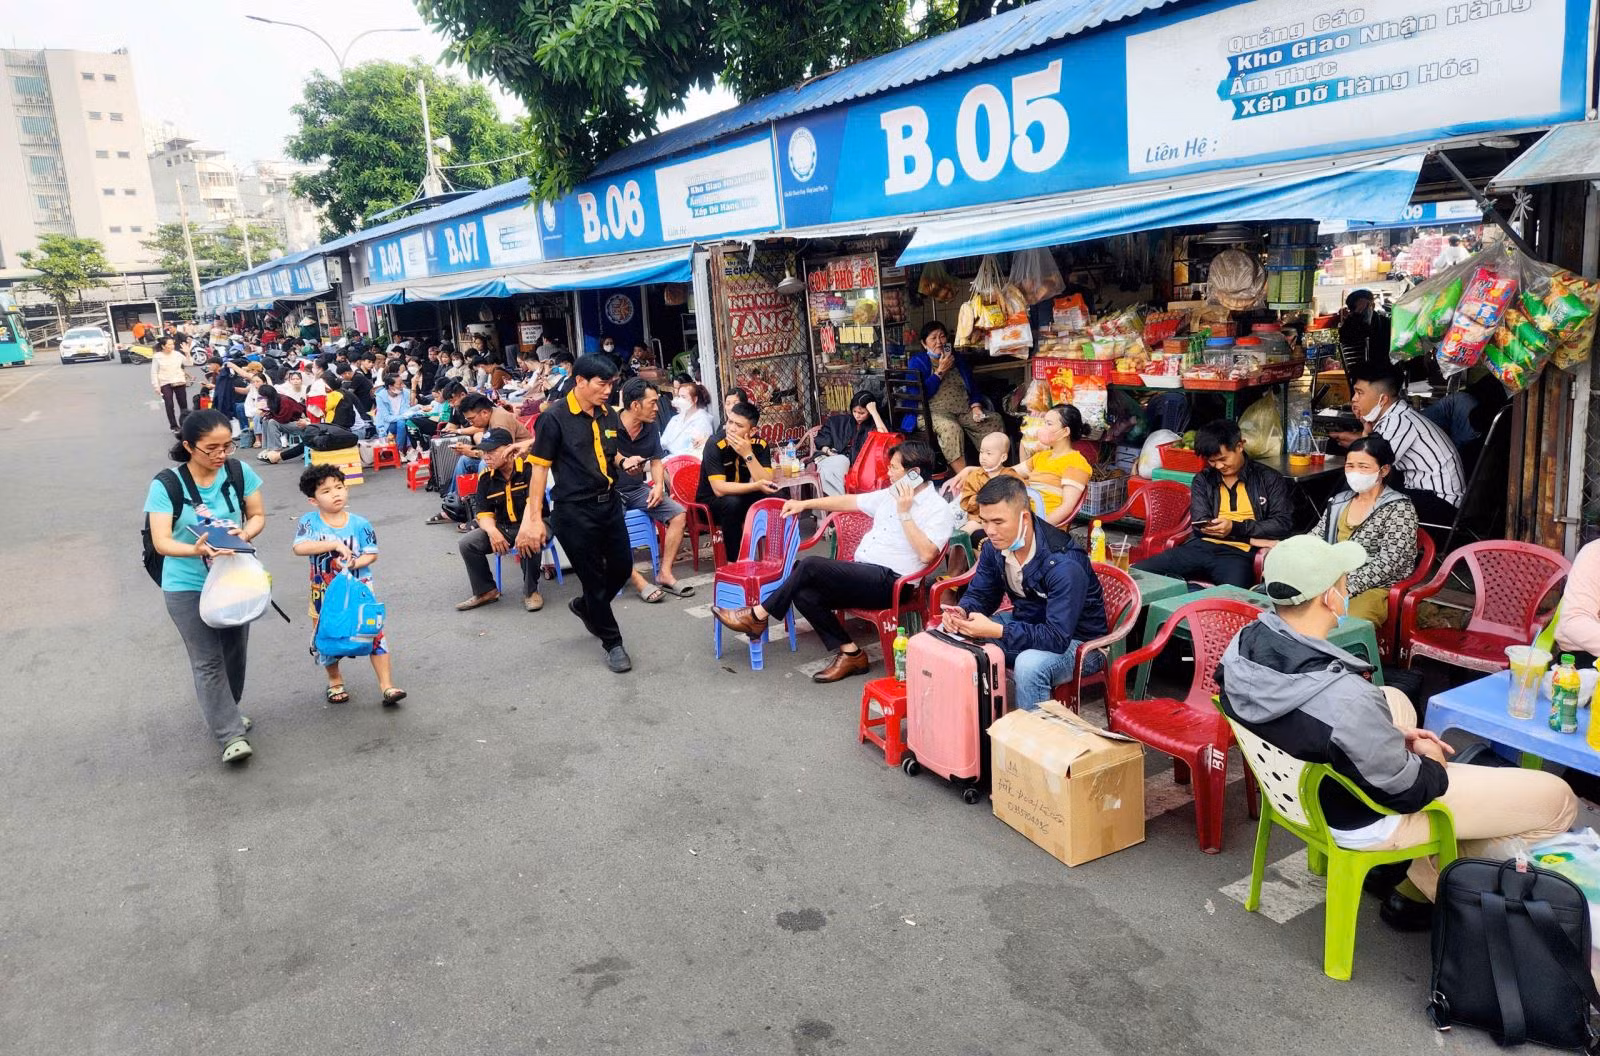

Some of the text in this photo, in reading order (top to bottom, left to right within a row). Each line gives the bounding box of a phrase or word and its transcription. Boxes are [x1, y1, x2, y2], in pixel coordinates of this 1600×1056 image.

[1228, 8, 1365, 54] Quảng Cáo
[1238, 0, 1531, 71] Kho Giao Nhận Hàng
[1241, 58, 1478, 116] Xếp Dỡ Hàng Hóa
[1275, 62, 1337, 86] Thực
[880, 58, 1070, 196] B.05
[1146, 143, 1179, 163] Liên
[1184, 137, 1207, 158] Hệ
[578, 180, 645, 244] B.06
[444, 222, 479, 264] B.07
